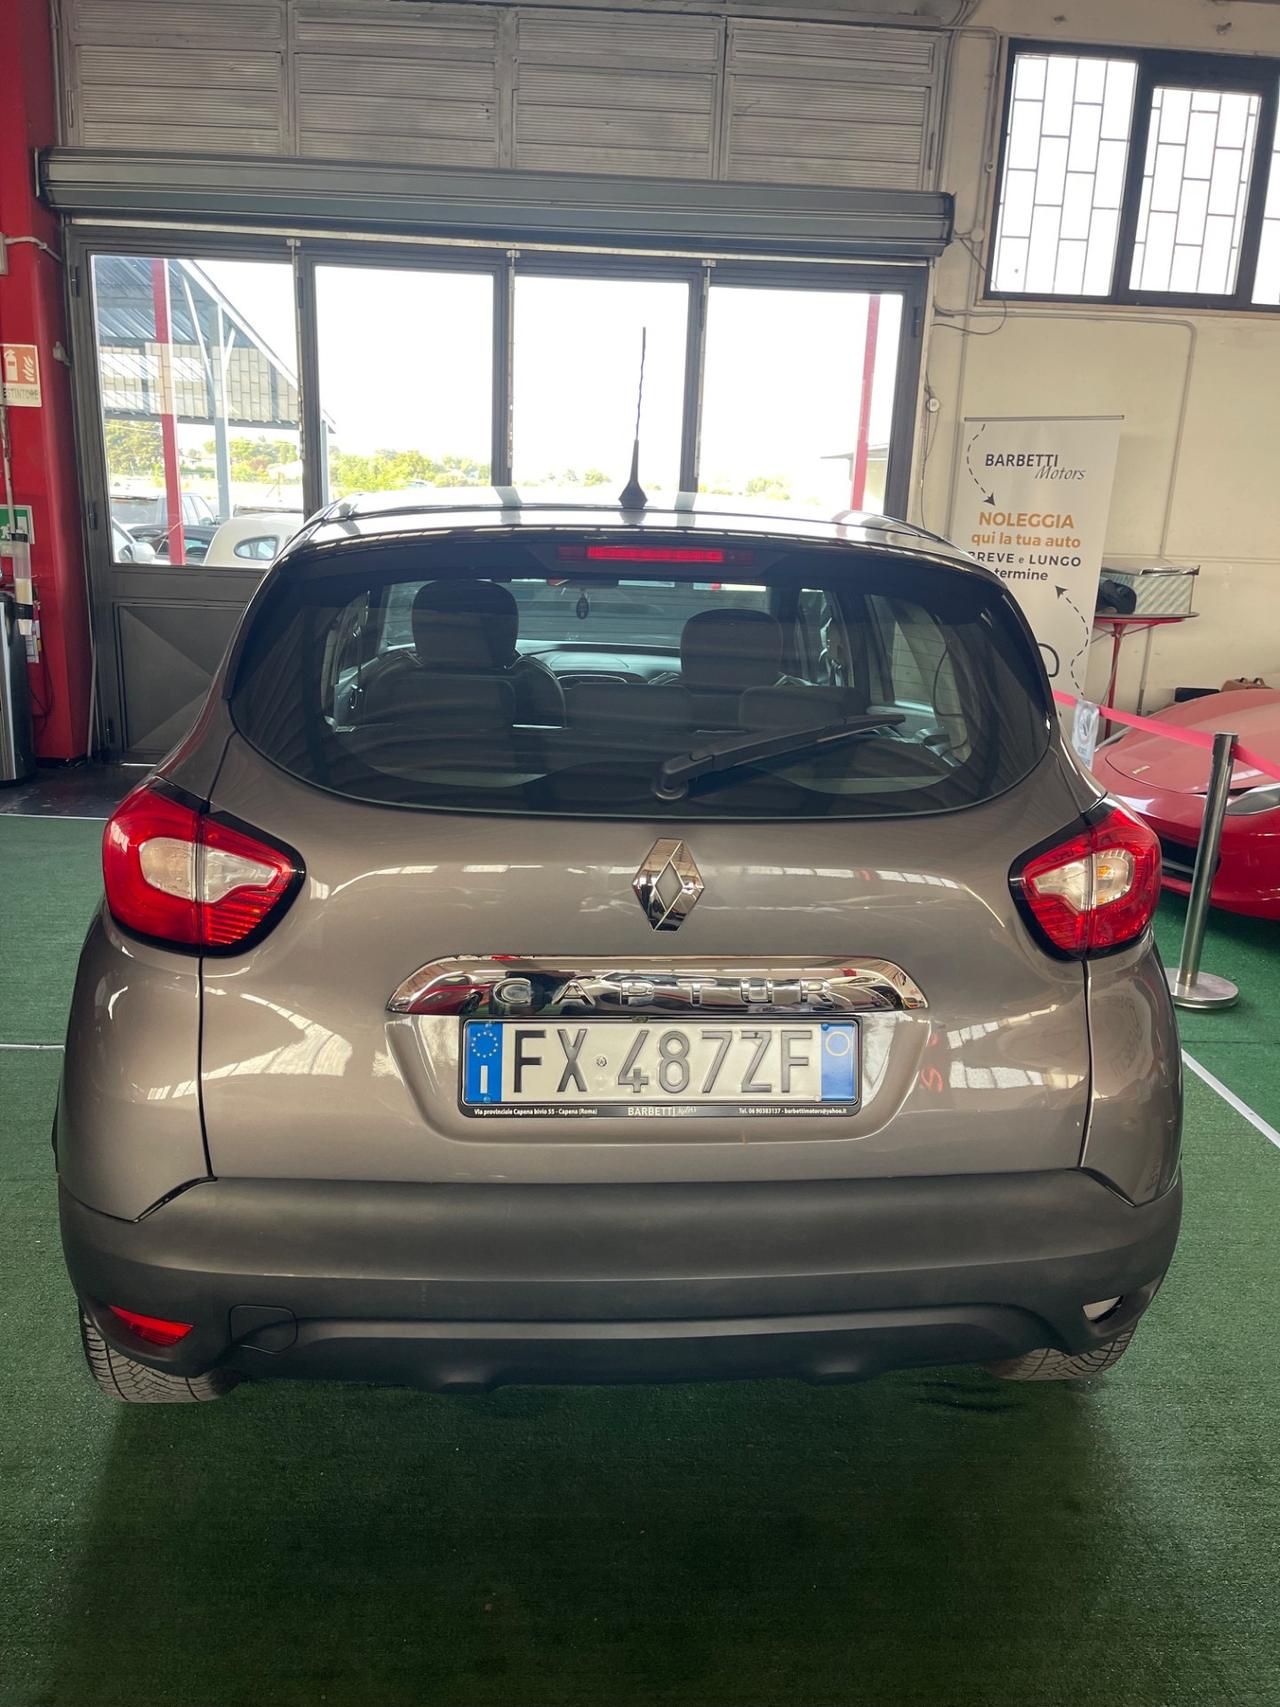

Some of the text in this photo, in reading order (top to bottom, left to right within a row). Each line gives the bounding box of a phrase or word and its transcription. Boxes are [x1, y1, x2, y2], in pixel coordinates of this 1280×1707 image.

[984, 453, 1059, 468] BARBETTI
[1034, 465, 1087, 480] Motors
[978, 511, 1075, 529] NOLEGGIA
[971, 531, 1081, 549] qui la tua auto
[1018, 556, 1025, 564] e
[1029, 554, 1082, 567] LUNGO
[493, 977, 834, 1008] CAPTUR
[513, 1029, 588, 1093] FX
[617, 1029, 813, 1094] 487ZF
[627, 1106, 676, 1117] BARBETTI
